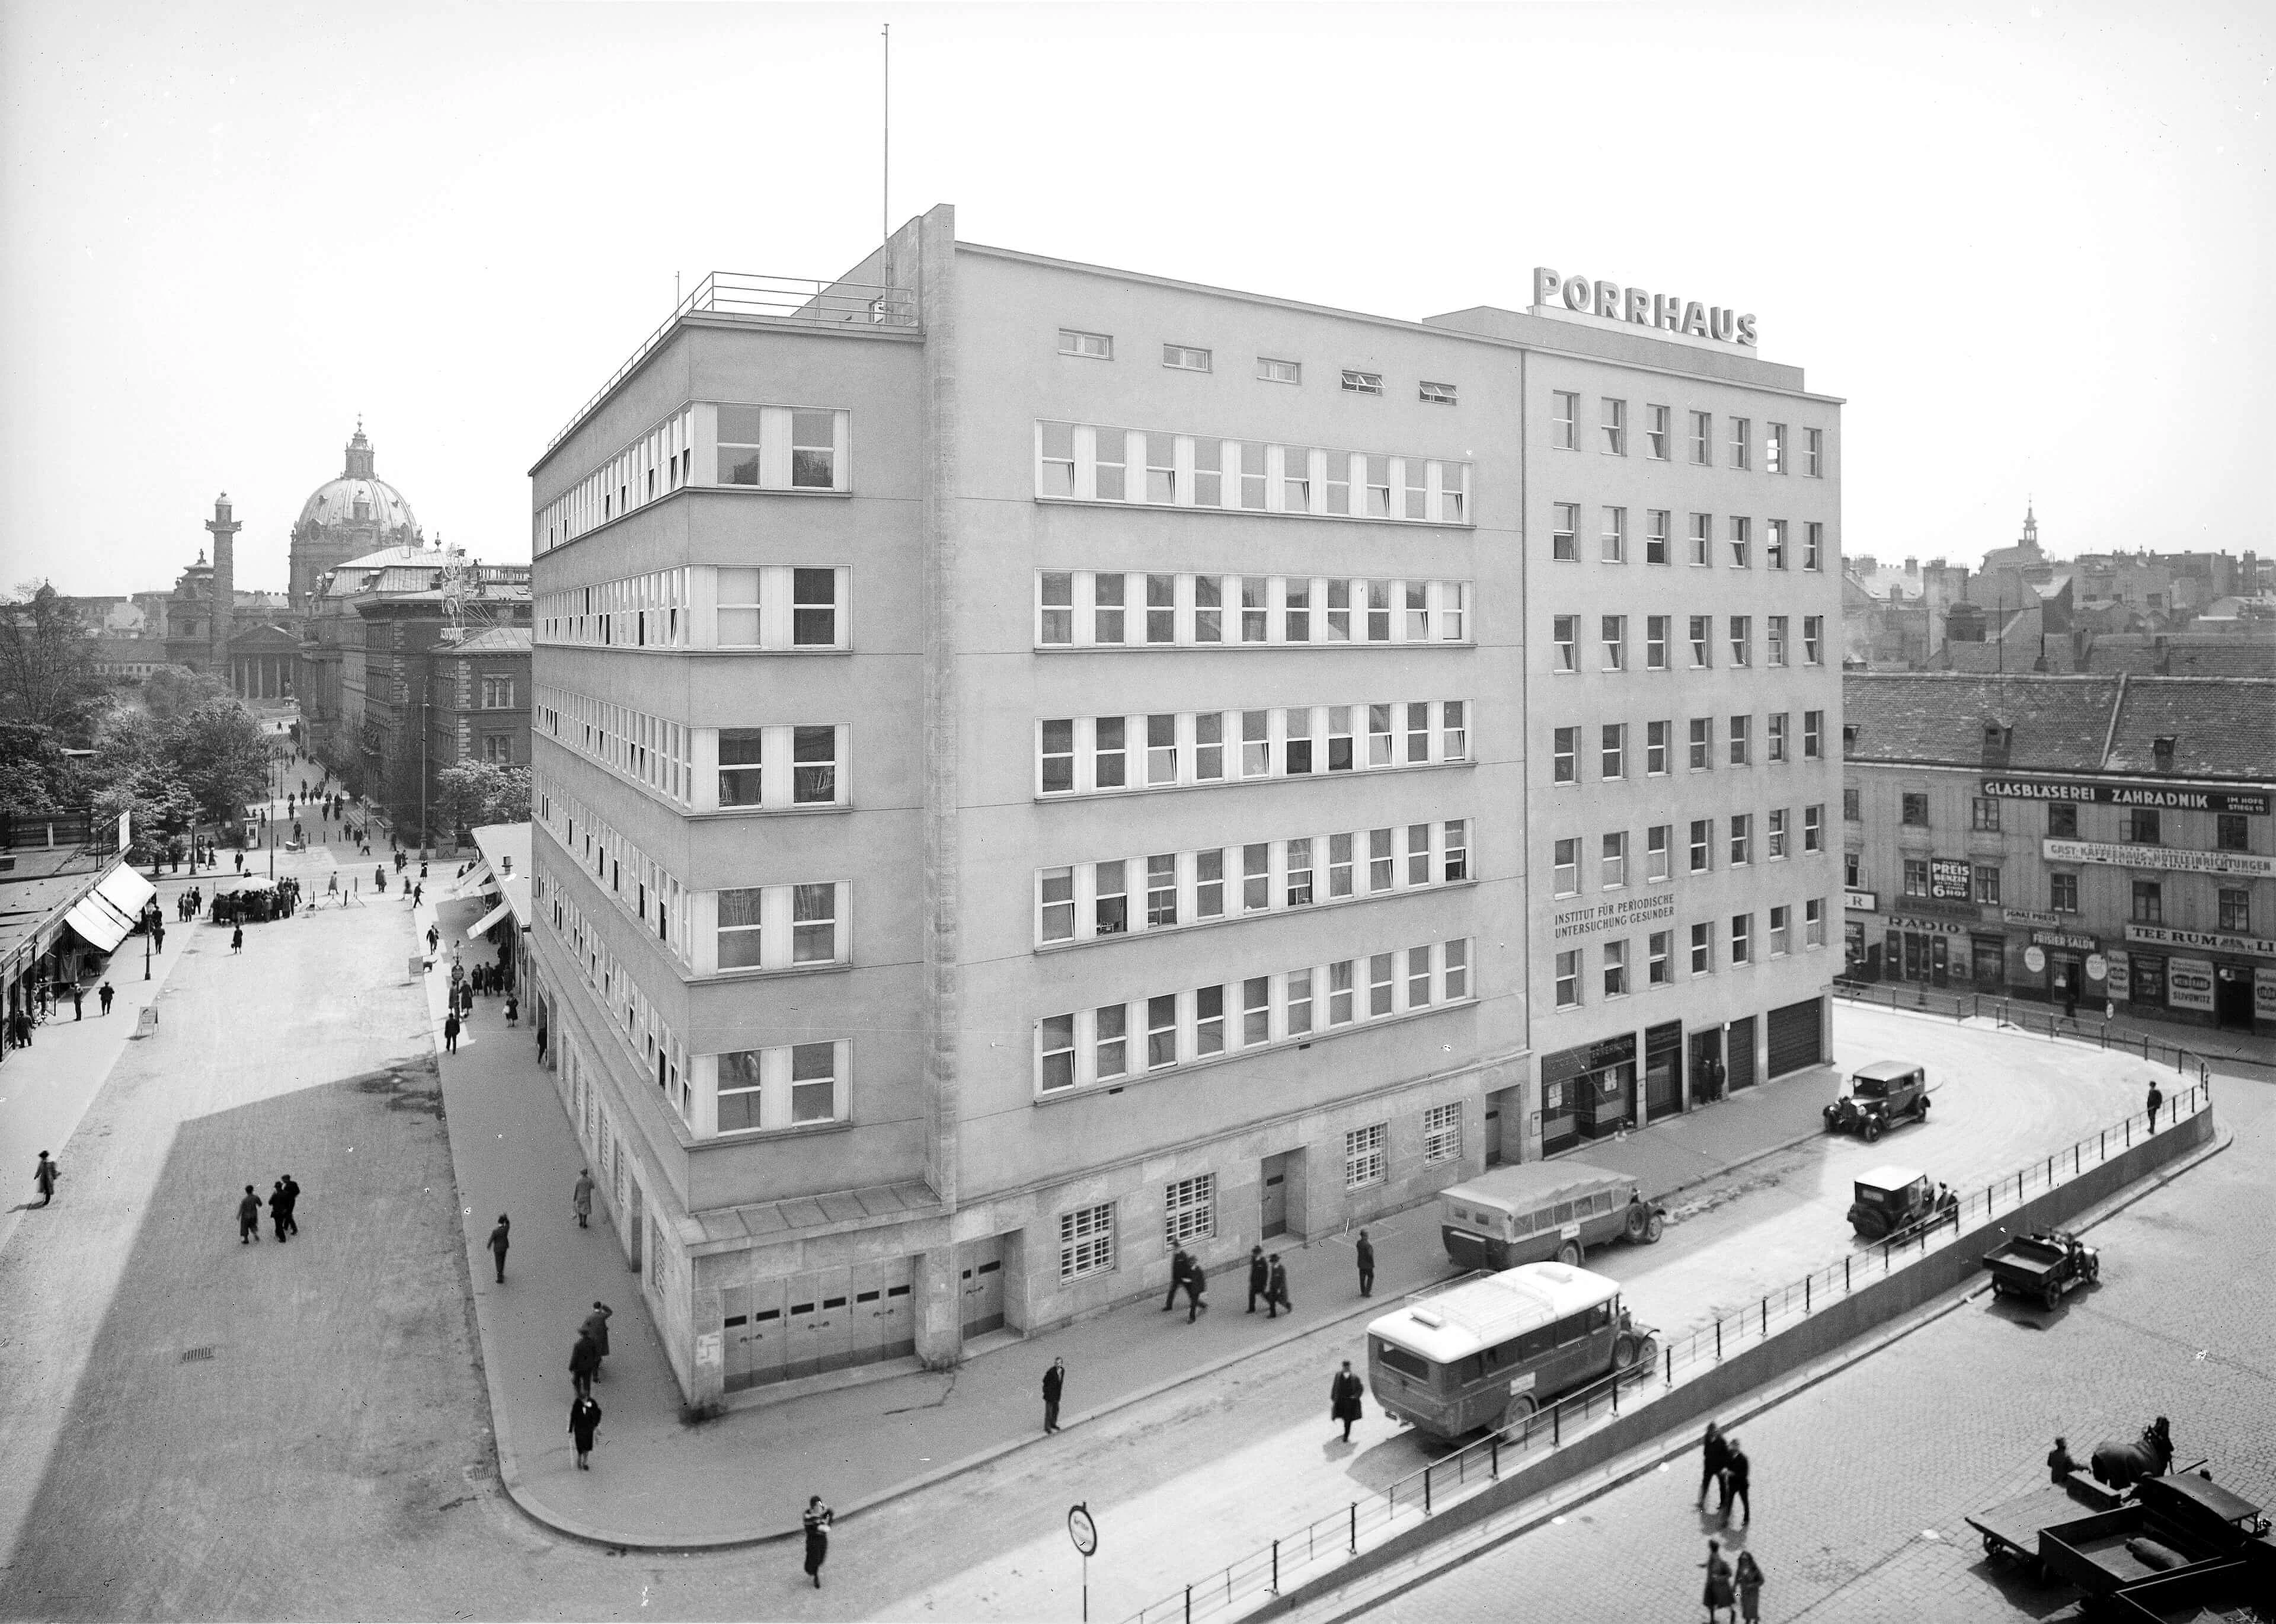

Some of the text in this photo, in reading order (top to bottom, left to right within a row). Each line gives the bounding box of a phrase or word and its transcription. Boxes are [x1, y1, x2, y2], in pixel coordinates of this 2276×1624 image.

[1533, 266, 1759, 347] PORRHAUS
[1985, 782, 2208, 808] GLASBLÄSEREI ZAHRADNIK
[1932, 862, 1970, 876] PREIS
[1932, 885, 1945, 898] 6
[1555, 893, 1674, 926] INSTITUT FÜR PERIODISCHE
[1555, 906, 1674, 939] UNTERSUCHUNG GESUNDER
[1889, 917, 1959, 934] RADIO
[2067, 936, 2096, 951] SALON
[2133, 927, 2167, 940] TEE
[2171, 931, 2217, 946] RUM
